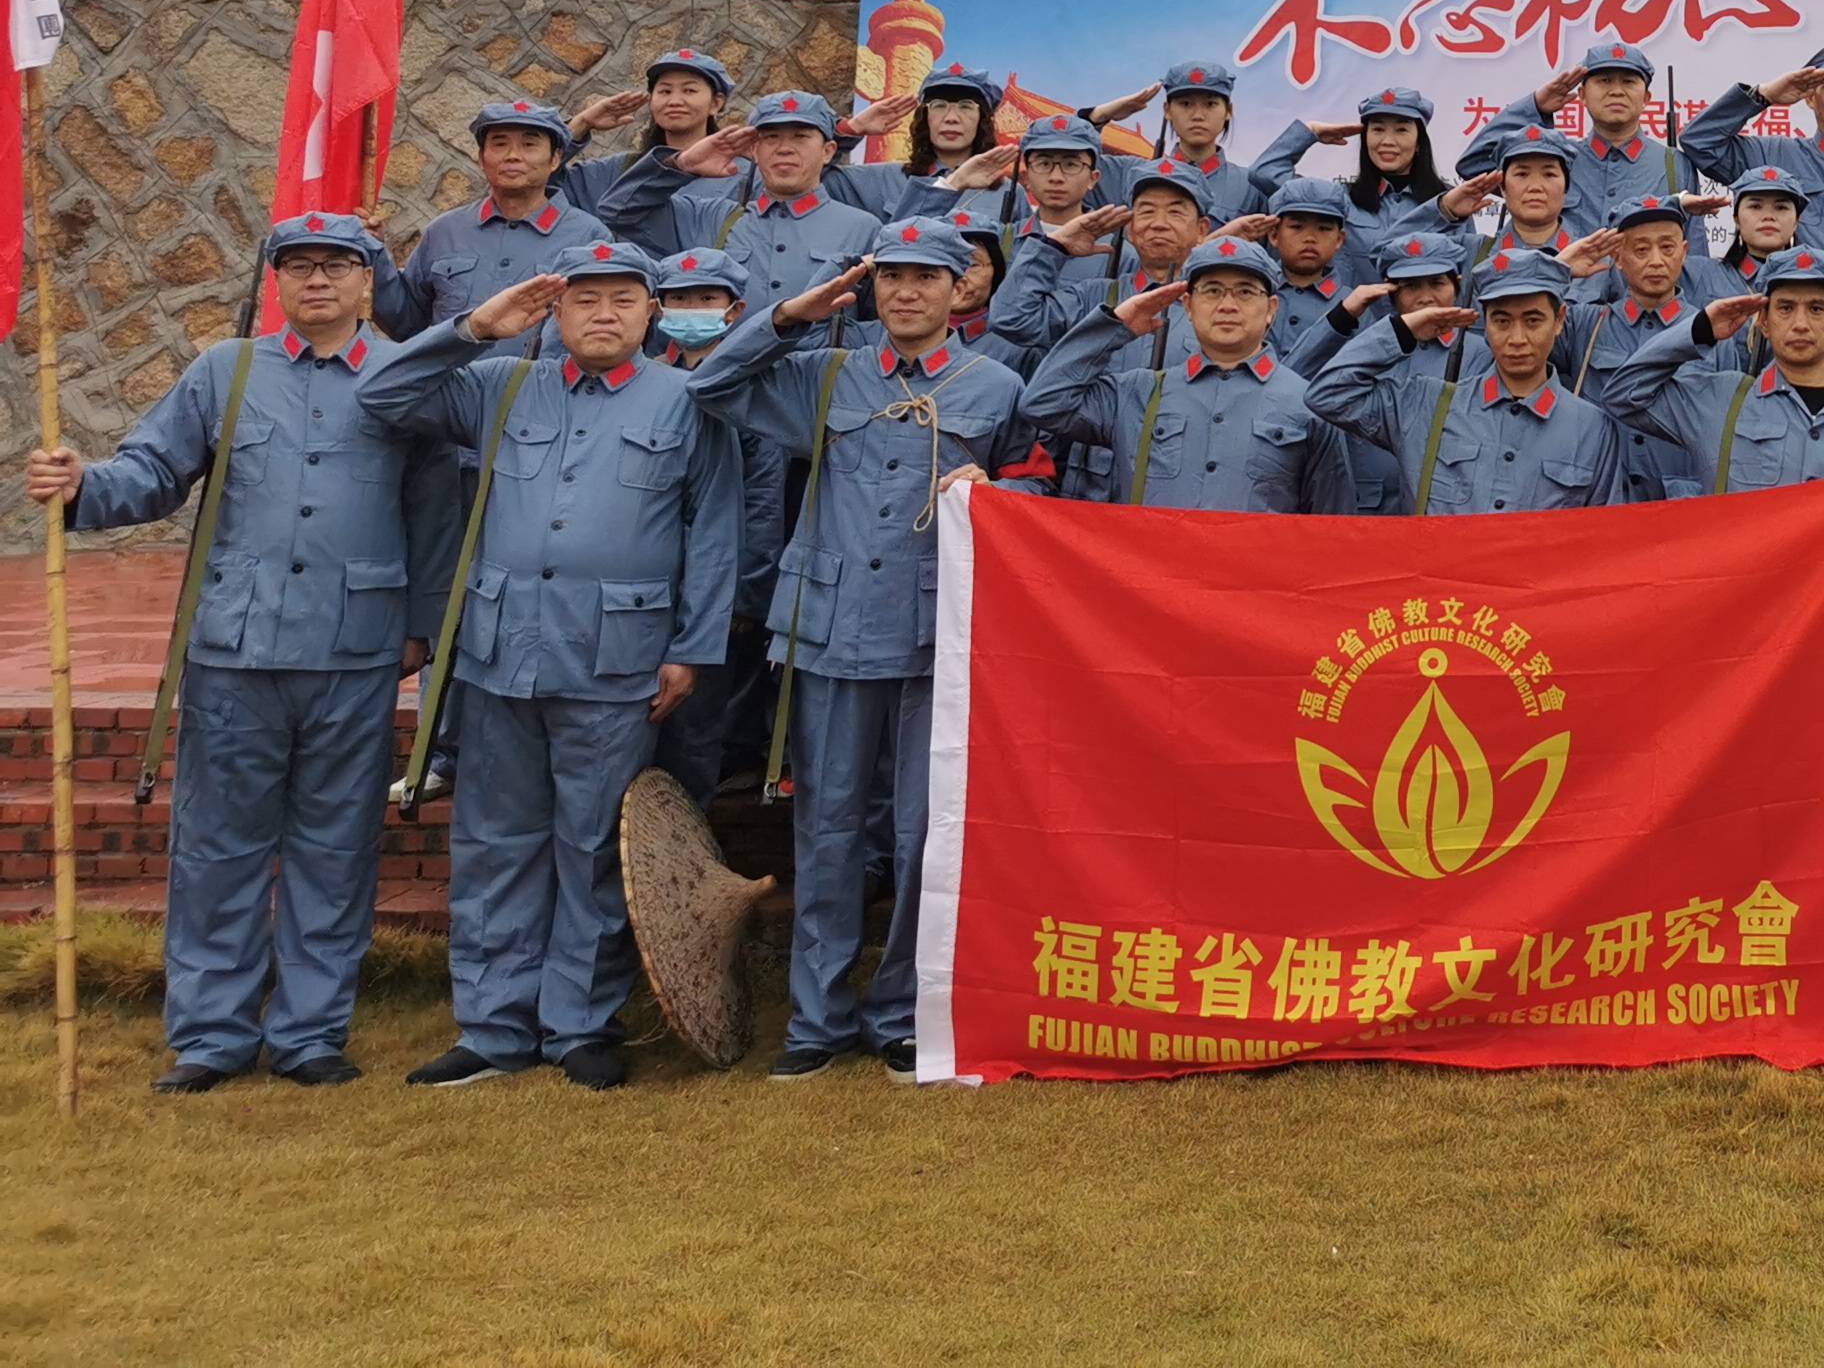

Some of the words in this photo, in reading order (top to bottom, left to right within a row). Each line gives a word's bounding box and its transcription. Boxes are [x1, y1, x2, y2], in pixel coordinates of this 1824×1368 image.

[1298, 597, 1566, 719] 福建省佛教文化研究會
[1326, 679, 1352, 723] FUJIAN
[1345, 634, 1400, 683] BUDDHIST
[1401, 627, 1455, 645] CULTURE
[1456, 629, 1514, 673] RESEARCH
[1508, 666, 1540, 718] SOCIETY
[1033, 879, 1800, 1023] 福建省佛教文化研究會
[1028, 1014, 1138, 1061] FUJIAN
[1666, 979, 1800, 1025] SOCIETY
